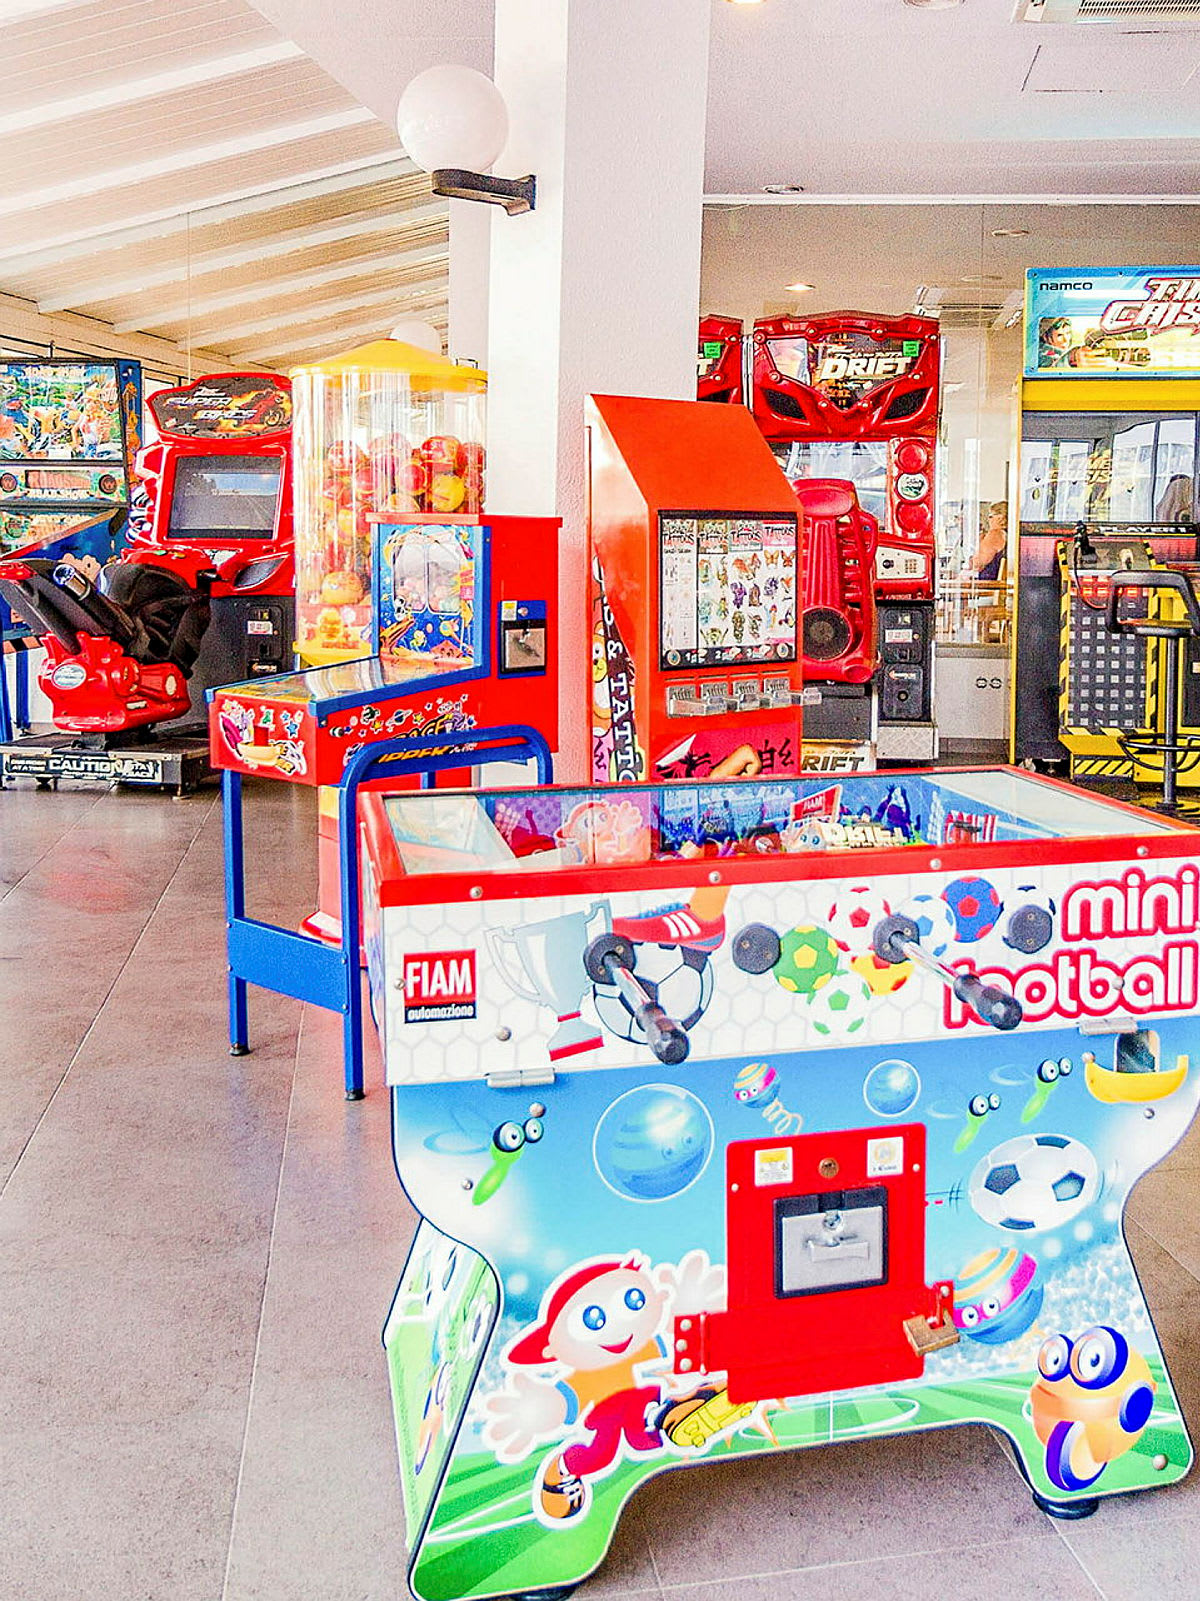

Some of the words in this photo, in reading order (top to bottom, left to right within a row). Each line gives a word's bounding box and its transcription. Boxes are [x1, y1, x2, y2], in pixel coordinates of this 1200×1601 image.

[1039, 281, 1093, 291] namco
[821, 356, 911, 380] DRIFT
[1100, 526, 1179, 534] PLAYER
[50, 758, 125, 774] CAUTION
[802, 754, 865, 772] RIFT
[1063, 865, 1199, 941] mini
[406, 958, 473, 998] FIAM
[407, 1003, 474, 1021] automazione
